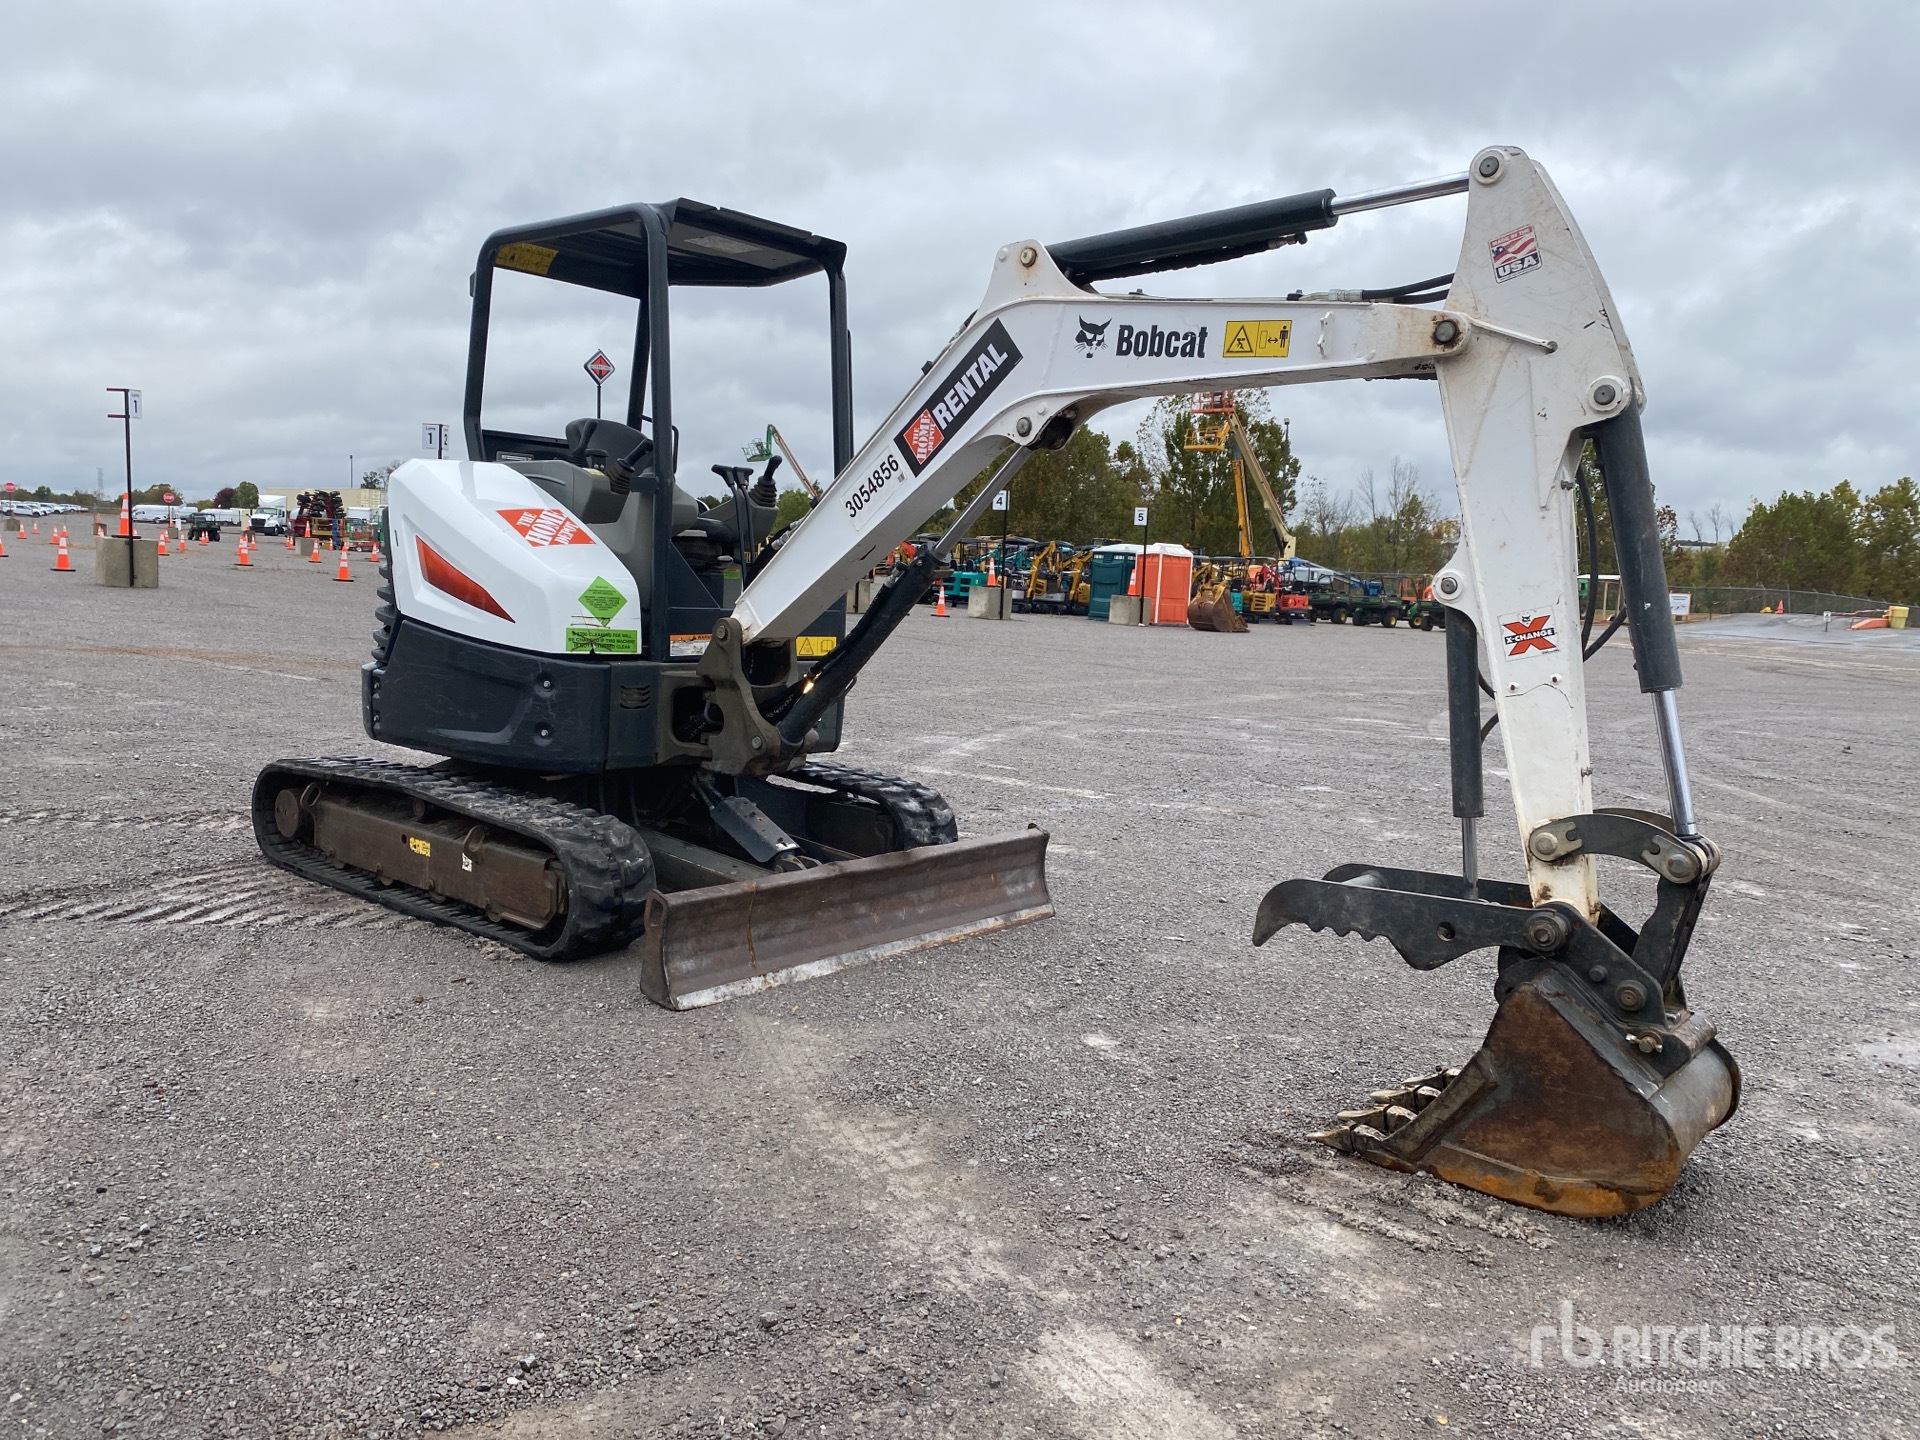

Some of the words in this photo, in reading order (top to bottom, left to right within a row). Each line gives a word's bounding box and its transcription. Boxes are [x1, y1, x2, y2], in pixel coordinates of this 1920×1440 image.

[1497, 255, 1537, 277] USA
[1116, 324, 1209, 359] Bobcat
[932, 343, 1009, 430] RENTAL
[133, 400, 138, 413] 1
[428, 432, 432, 445] 1
[912, 427, 920, 446] THE
[916, 414, 931, 459] HOME
[927, 420, 937, 451] DEPOT
[845, 454, 899, 518] 3054856
[995, 497, 1003, 506] 4
[516, 511, 538, 527] THE
[525, 510, 567, 546] HOME
[1137, 513, 1144, 522] 5
[554, 521, 579, 545] DEPOT
[1505, 629, 1553, 644] X-CHANGE
